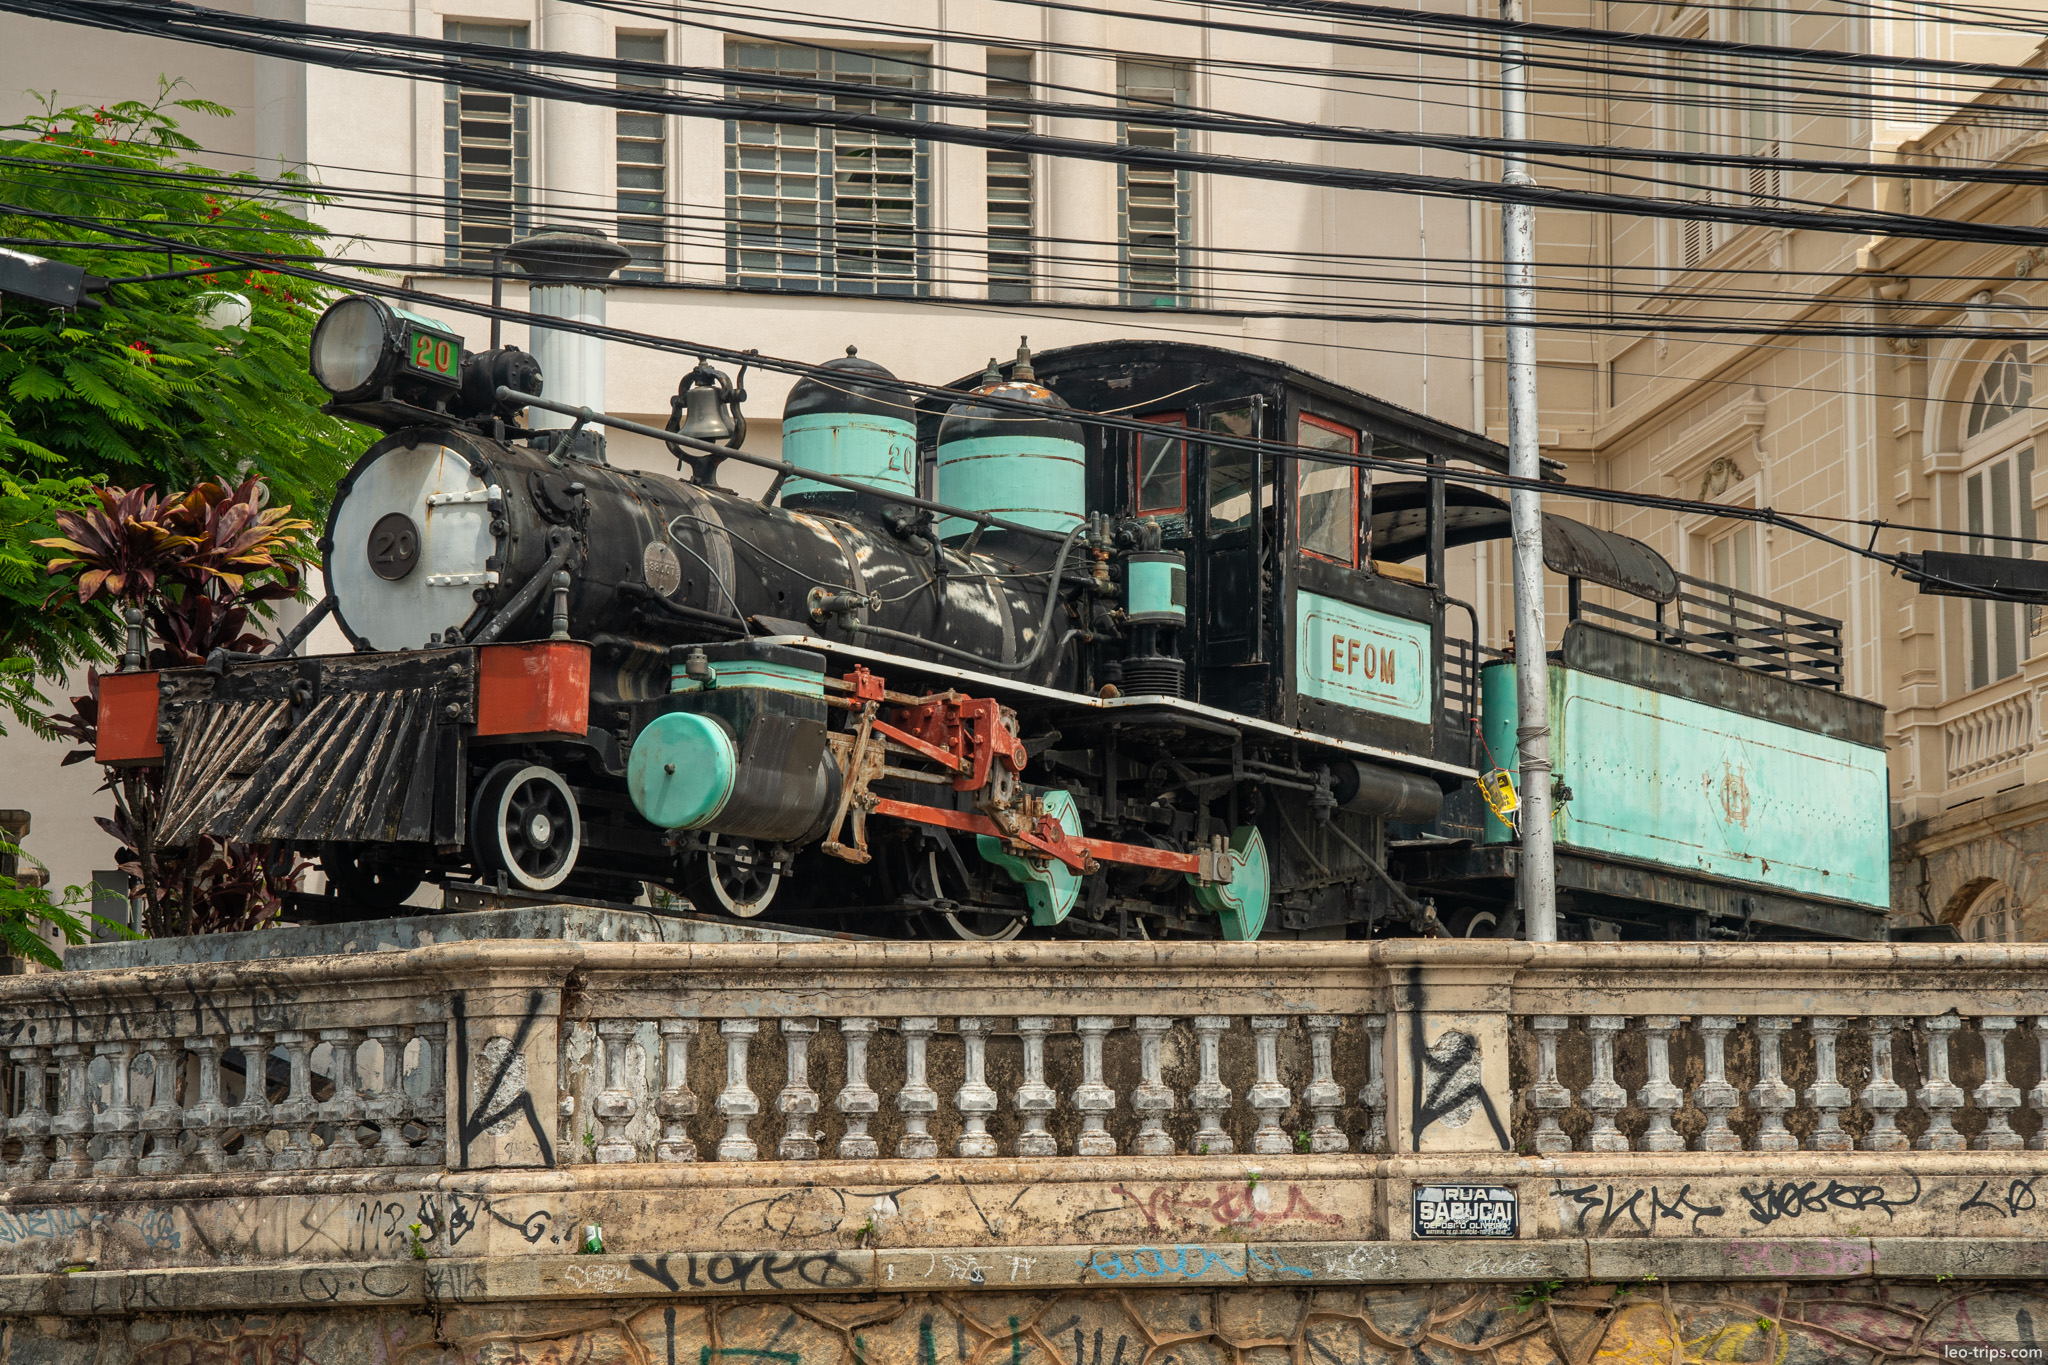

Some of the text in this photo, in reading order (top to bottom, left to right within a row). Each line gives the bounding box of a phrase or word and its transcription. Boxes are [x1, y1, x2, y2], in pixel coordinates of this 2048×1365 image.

[416, 335, 450, 373] 20
[888, 443, 912, 475] 20
[375, 530, 415, 564] 20
[1332, 634, 1396, 685] EFOM
[1445, 1188, 1488, 1201] RUA
[1423, 1222, 1467, 1230] DEPOSIO
